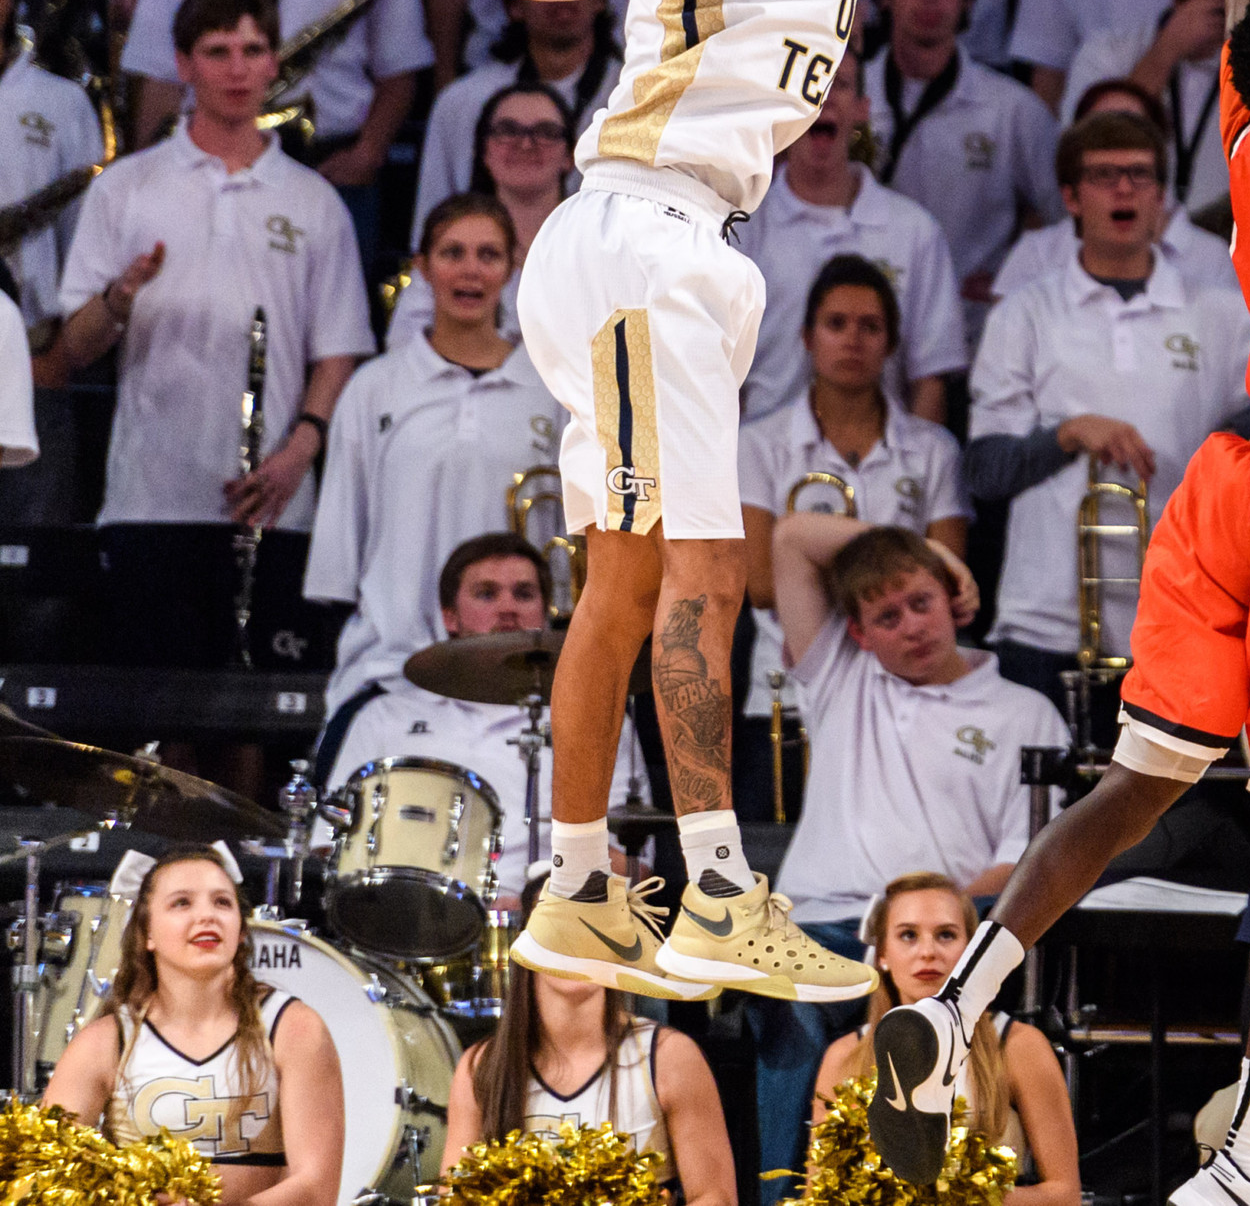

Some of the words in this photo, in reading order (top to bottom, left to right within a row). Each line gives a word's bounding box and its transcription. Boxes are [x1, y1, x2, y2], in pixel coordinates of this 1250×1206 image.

[776, 37, 835, 109] TE
[605, 464, 657, 501] GT
[251, 944, 301, 968] AHA
[133, 1075, 270, 1155] GT
